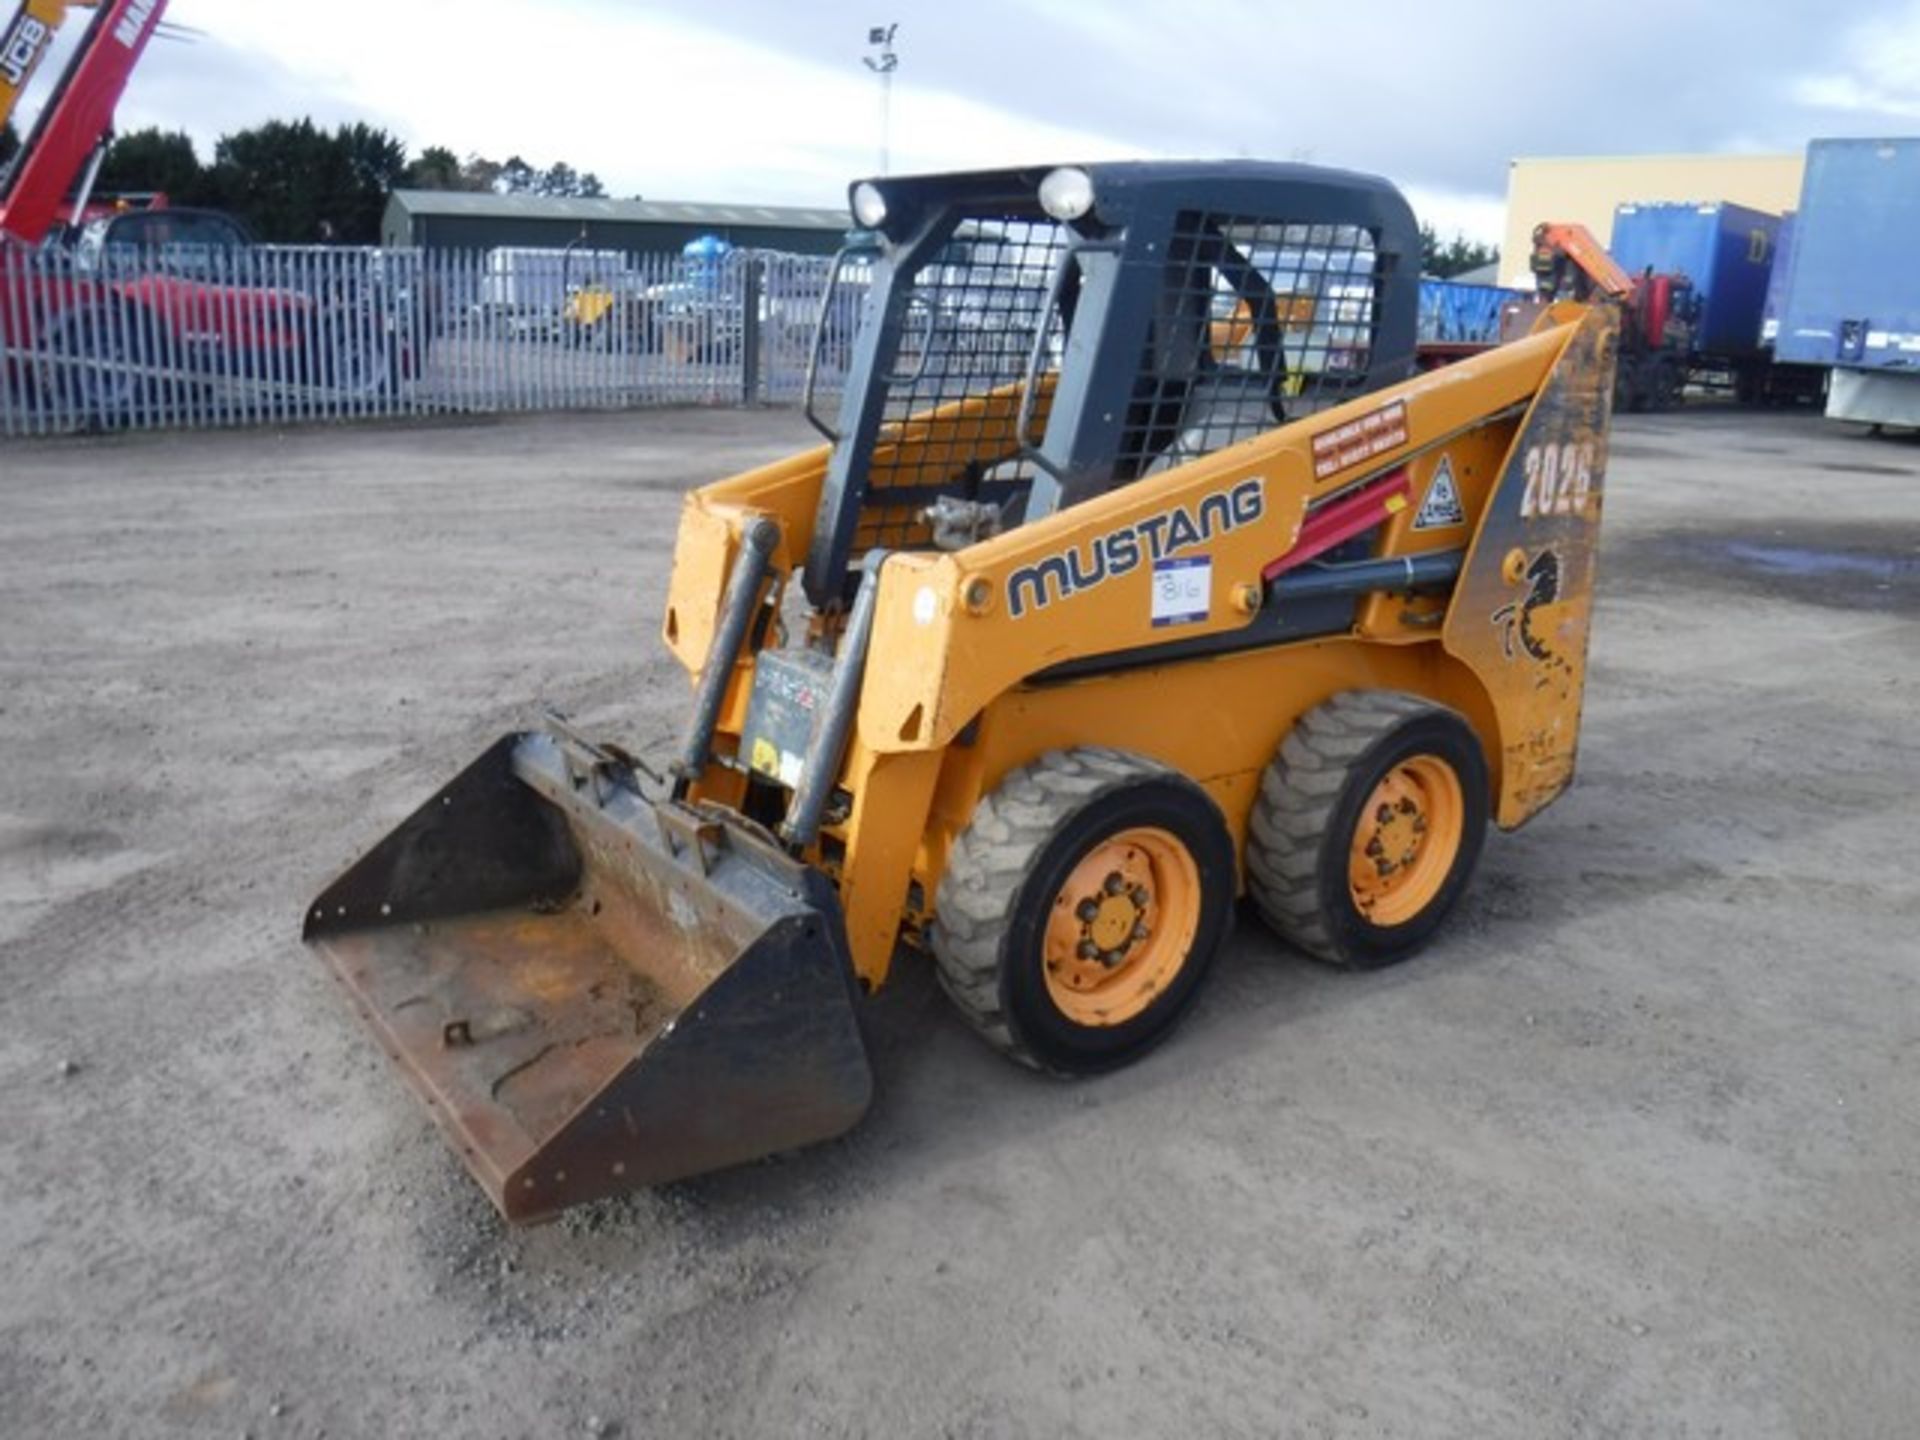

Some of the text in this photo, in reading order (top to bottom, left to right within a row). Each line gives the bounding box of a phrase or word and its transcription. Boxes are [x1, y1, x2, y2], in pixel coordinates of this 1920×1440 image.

[5, 17, 46, 86] JCB
[1007, 478, 1264, 618] MUSTANG
[1161, 579, 1201, 601] 816
